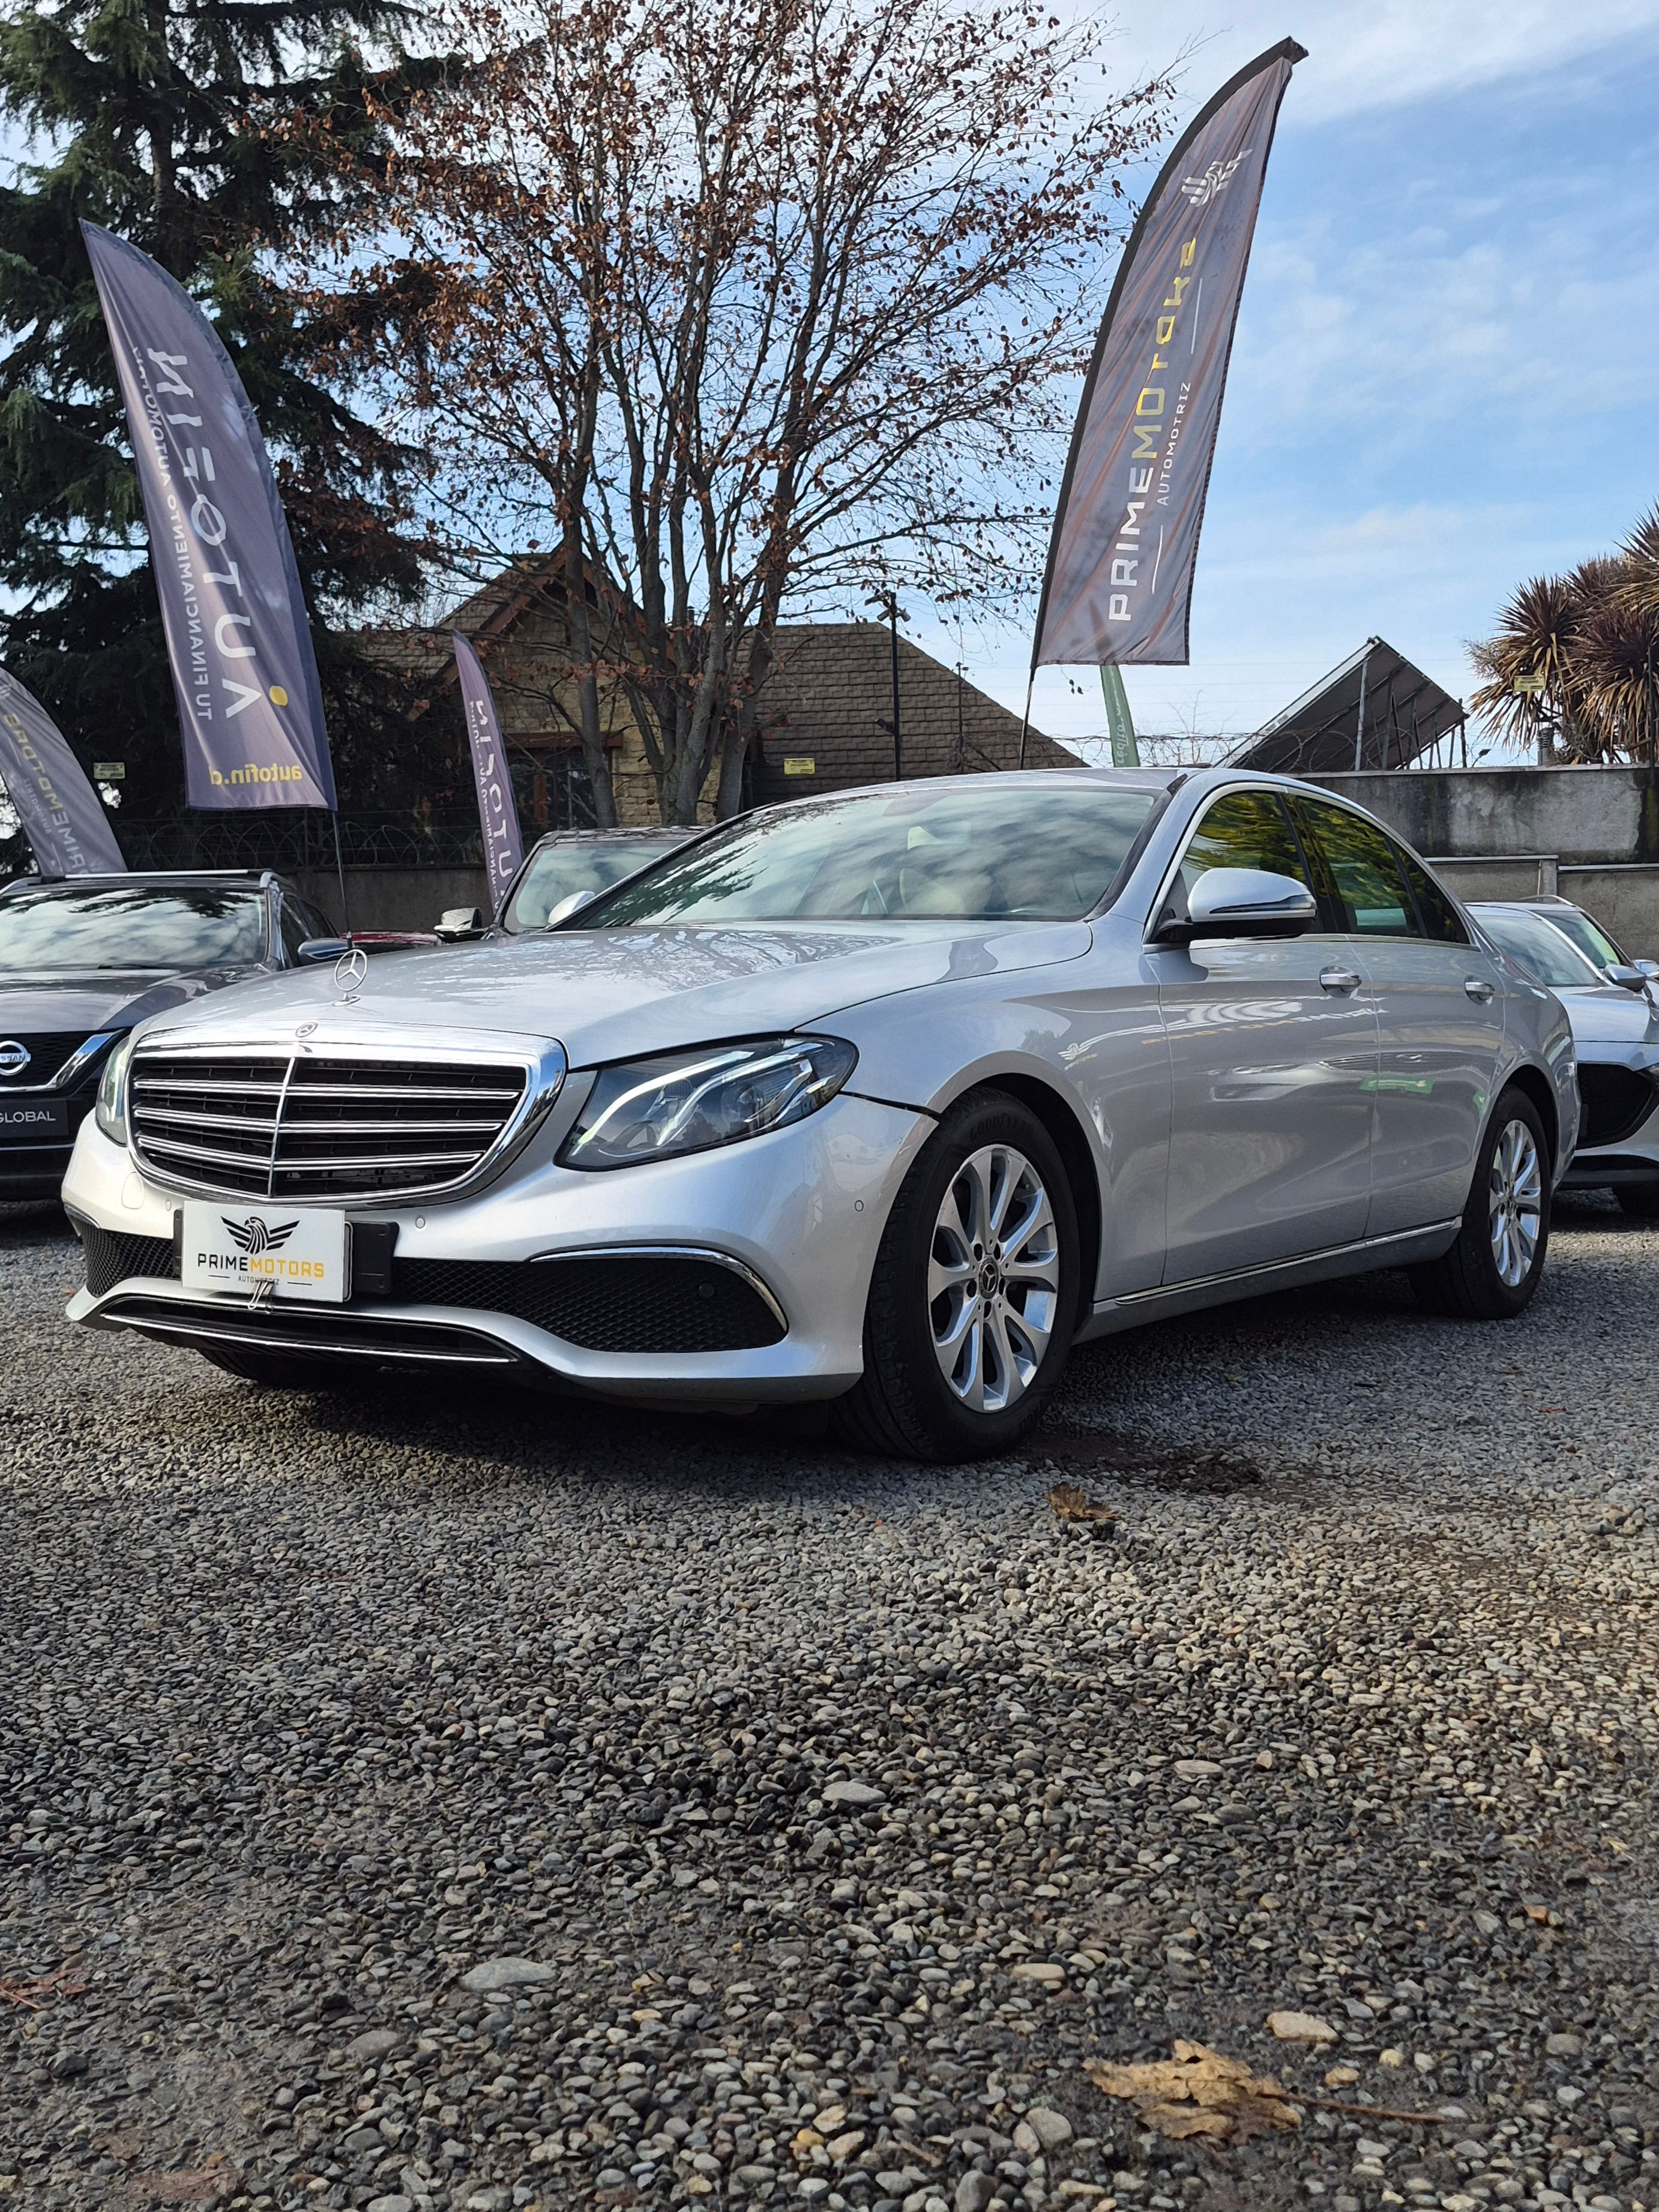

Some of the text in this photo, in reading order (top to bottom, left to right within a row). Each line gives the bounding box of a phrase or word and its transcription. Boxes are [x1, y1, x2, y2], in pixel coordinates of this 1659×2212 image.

[1157, 382, 1191, 506] AUTOMOTRIZ
[197, 1253, 325, 1279] PRIMEMOTORS
[238, 1275, 280, 1285] AUTOZ
